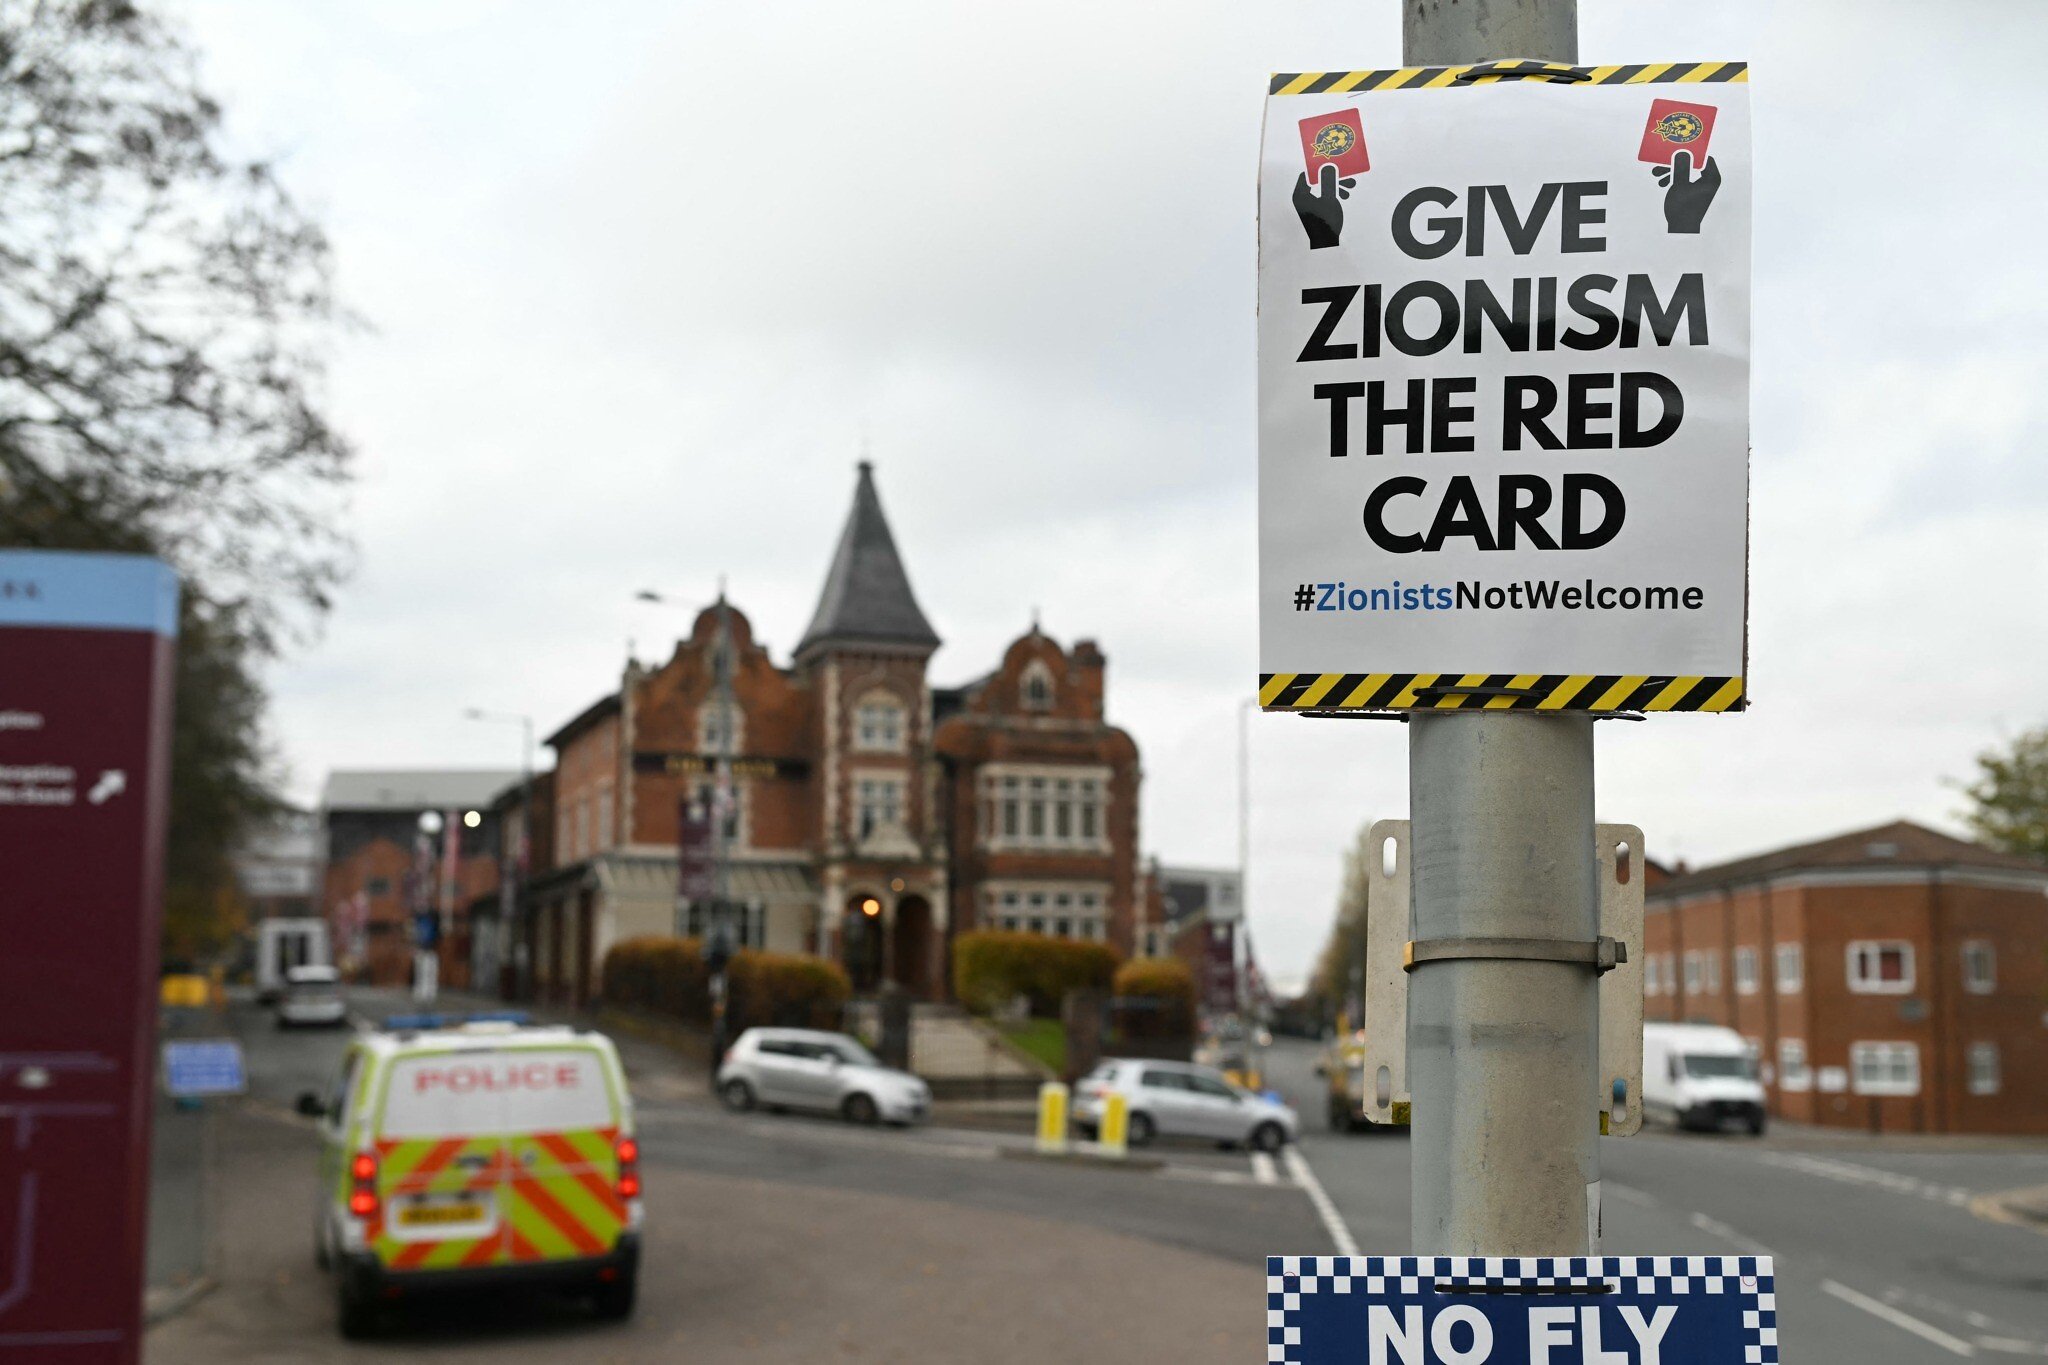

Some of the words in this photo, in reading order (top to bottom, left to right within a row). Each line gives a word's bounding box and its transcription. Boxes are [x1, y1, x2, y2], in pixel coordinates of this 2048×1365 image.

[1391, 180, 1608, 260] GIVE
[1296, 273, 1709, 362] ZIONISM
[1314, 377, 1476, 458] THE
[1503, 371, 1684, 451] RED
[1363, 473, 1626, 553] CARD
[1294, 579, 1704, 612] #ZionistsNotWelcome
[414, 1062, 580, 1093] POLICE
[1369, 1304, 1494, 1365] NO
[1529, 1305, 1679, 1365] FLY
